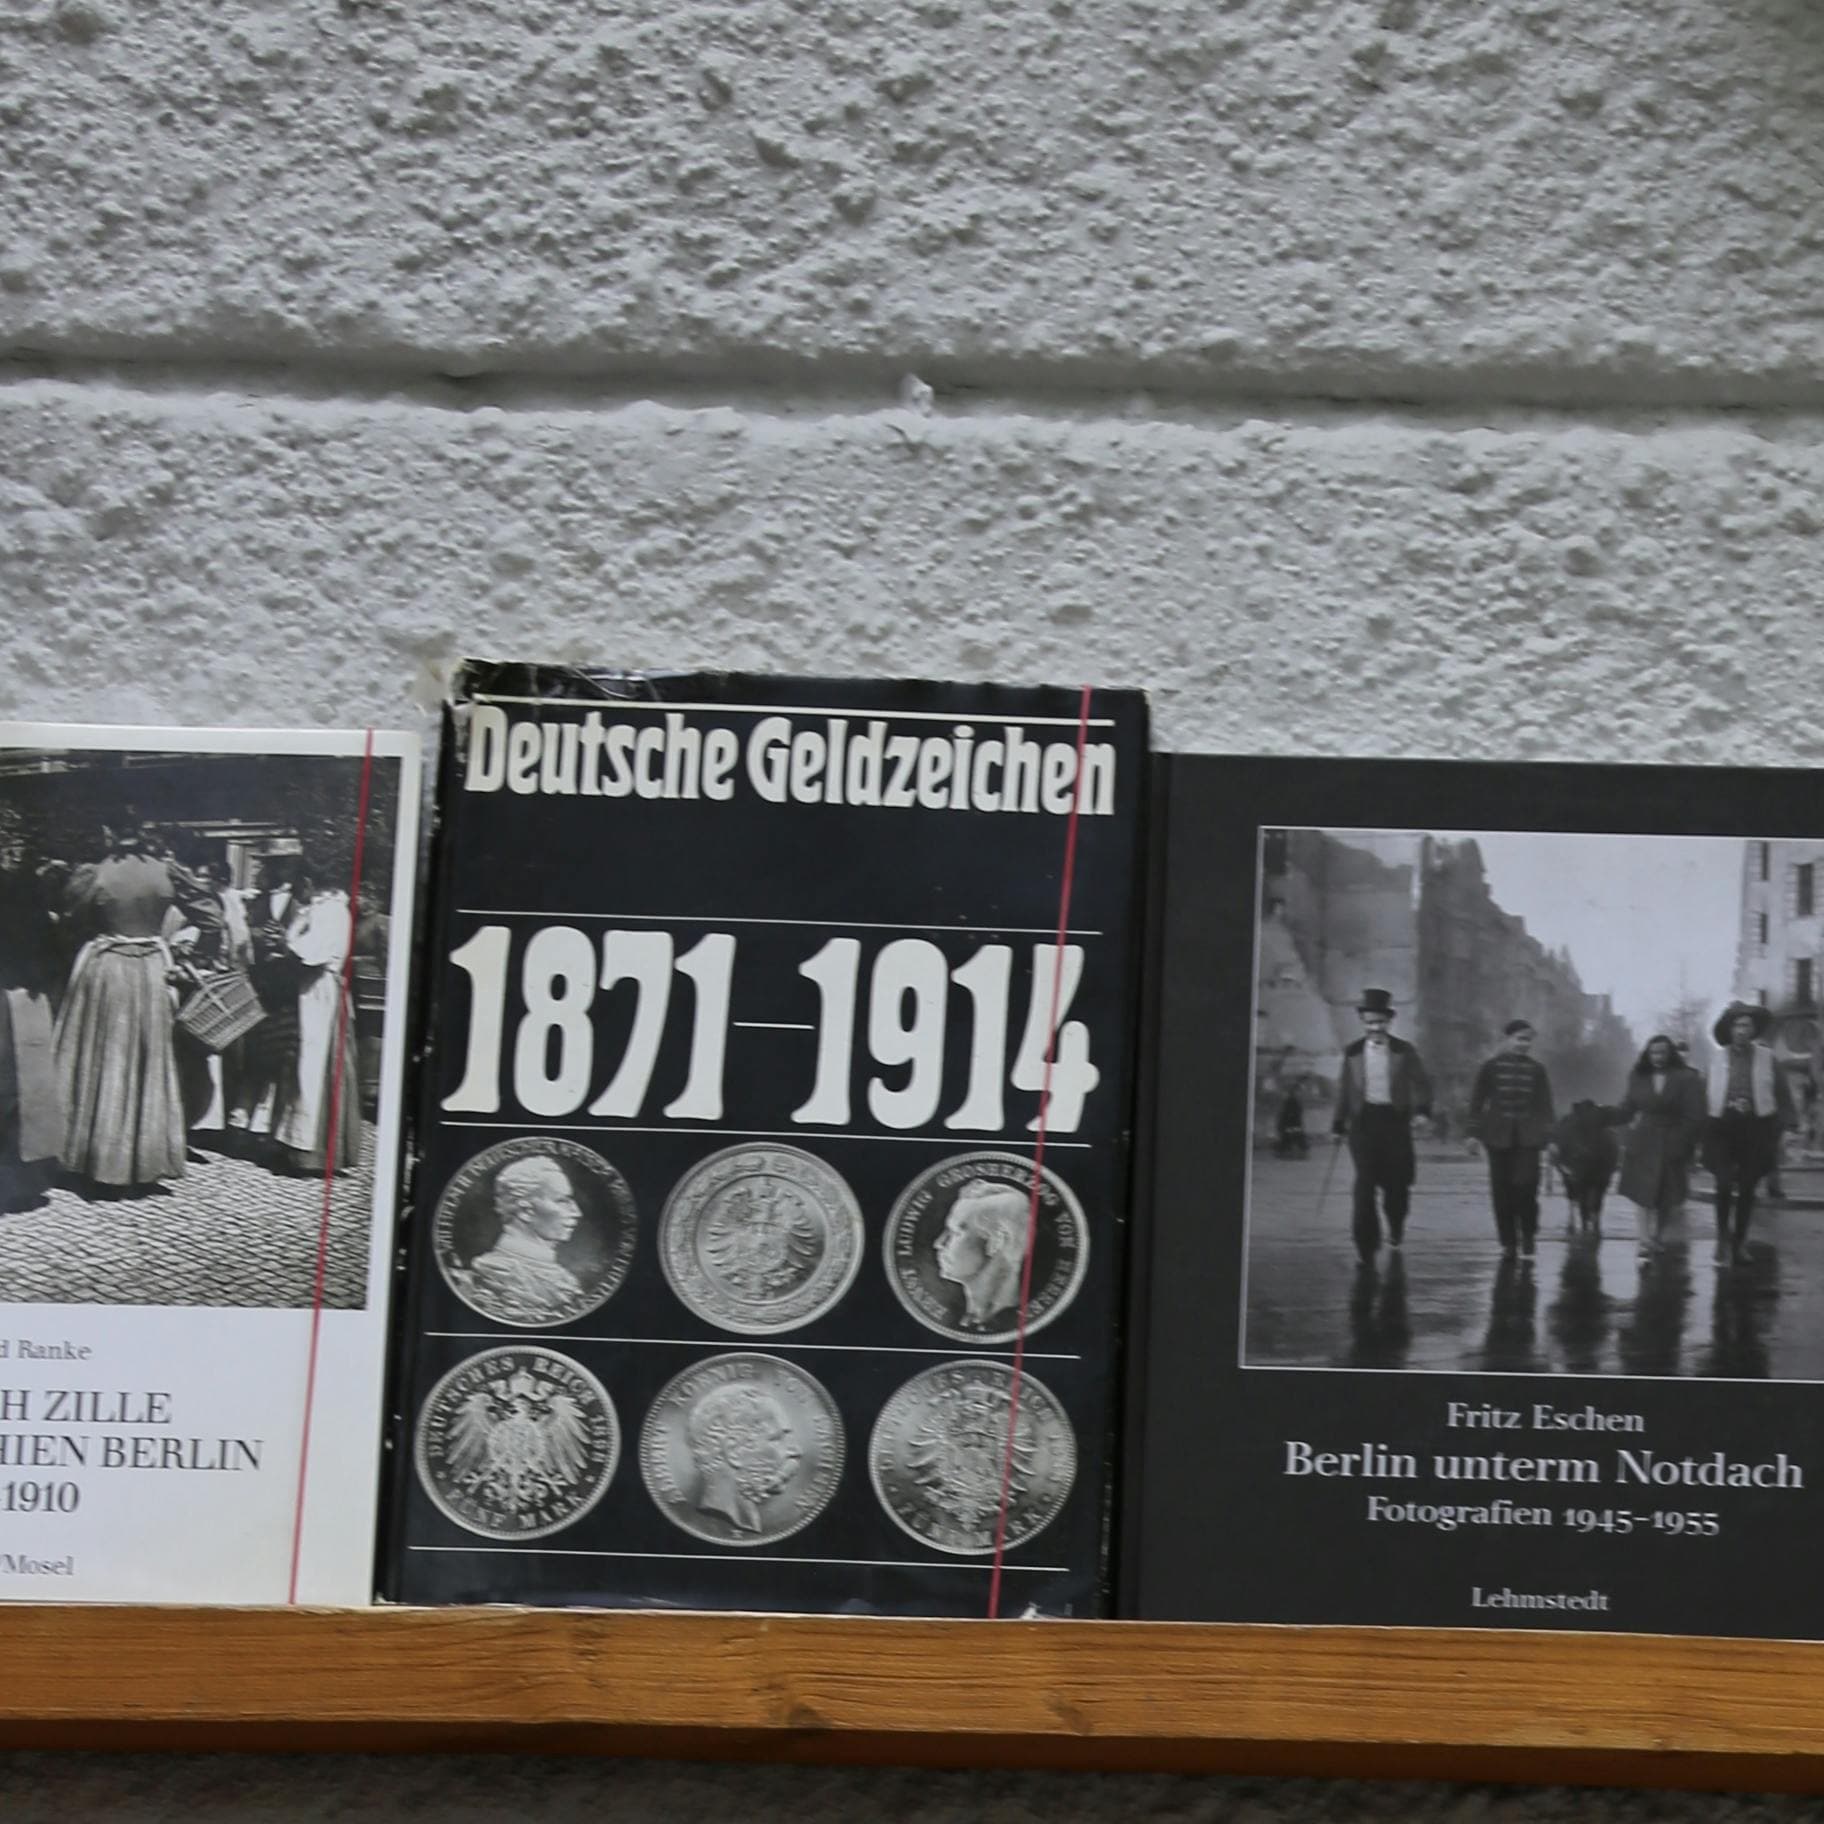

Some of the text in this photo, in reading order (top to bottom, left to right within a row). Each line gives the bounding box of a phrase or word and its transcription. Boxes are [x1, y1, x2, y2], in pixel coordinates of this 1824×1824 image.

[464, 706, 1115, 816] Deutsche Geldzeichen
[18, 1339, 92, 1361] Ranke
[44, 1390, 172, 1424] ZILLE
[1446, 1401, 1645, 1434] Fritz Eschen
[98, 1435, 264, 1471] BERLIN
[1283, 1442, 1805, 1490] Berlin unterm Notdach
[4, 1481, 80, 1513] 1910
[1367, 1495, 1552, 1536] Fotografien
[2, 1554, 74, 1577] Mosel
[1471, 1586, 1610, 1614] Lehmstedt
